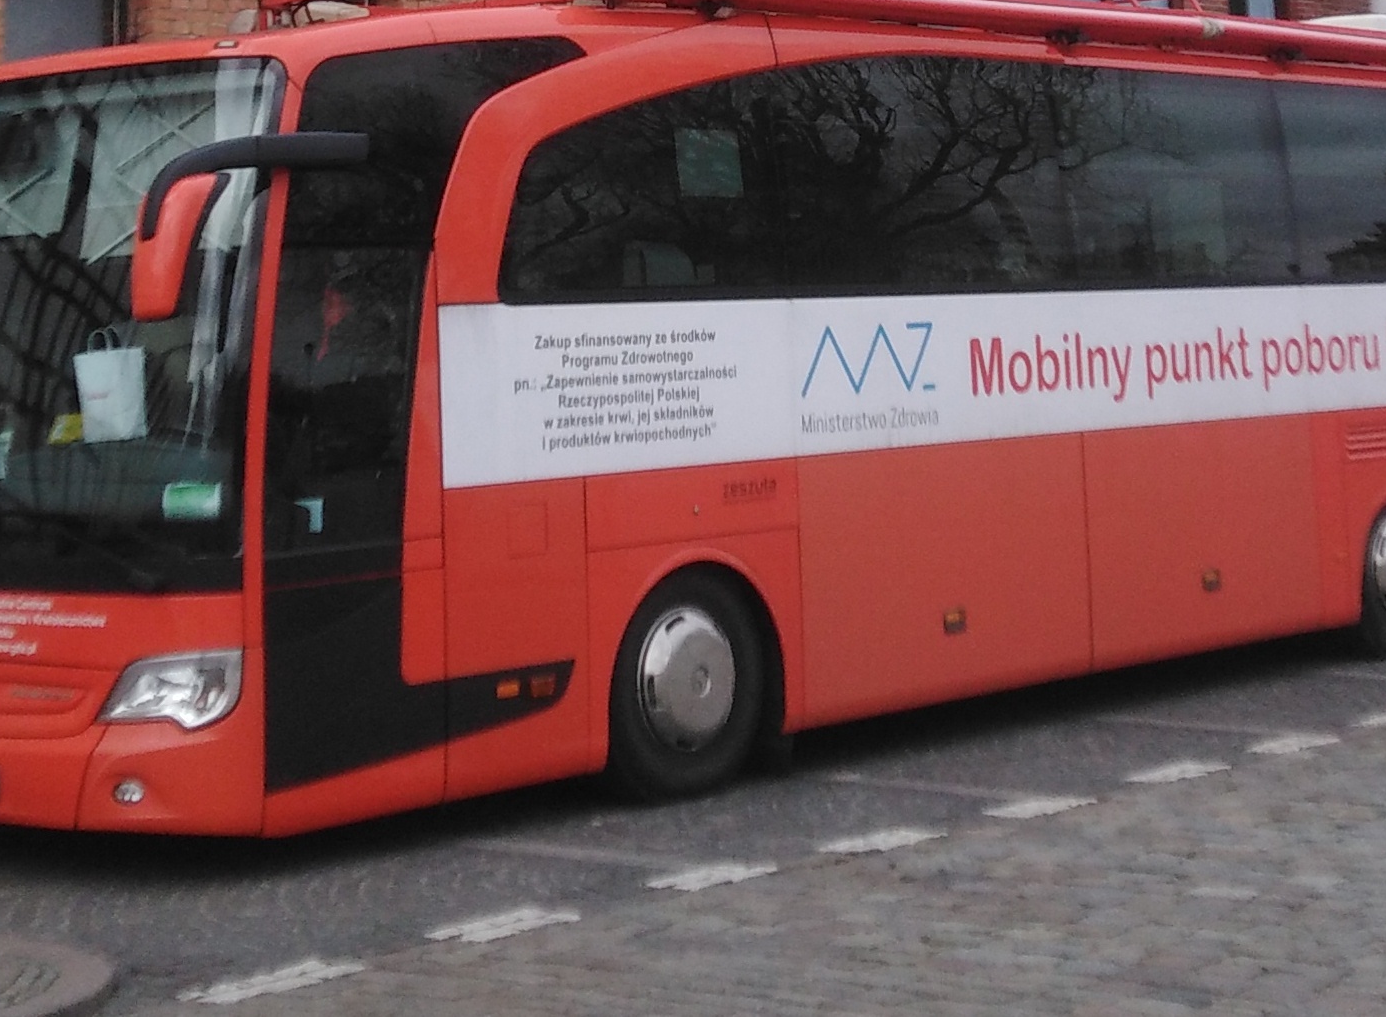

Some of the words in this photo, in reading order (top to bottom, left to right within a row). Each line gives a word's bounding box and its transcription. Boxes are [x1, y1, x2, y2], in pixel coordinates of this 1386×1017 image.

[534, 335, 572, 351] Zakup
[574, 331, 652, 348] sfinansowany
[655, 332, 667, 345] ze
[670, 328, 717, 344] środków
[561, 353, 618, 370] Programu
[621, 350, 694, 366] Zdrowotnego
[968, 330, 1132, 403] Mobilny
[1145, 326, 1254, 399] punkt
[1262, 323, 1382, 391] poboru
[622, 364, 738, 385] samowystarczalności
[558, 389, 655, 410] Rzeczypospolitej
[657, 386, 700, 403] Polskiej
[543, 418, 554, 429] w
[556, 412, 605, 429] zakresie
[637, 408, 651, 426] jej
[653, 404, 715, 421] składników
[801, 412, 887, 433] Ministerstwo
[890, 407, 939, 429] Zdrowia
[549, 432, 611, 452] produktów
